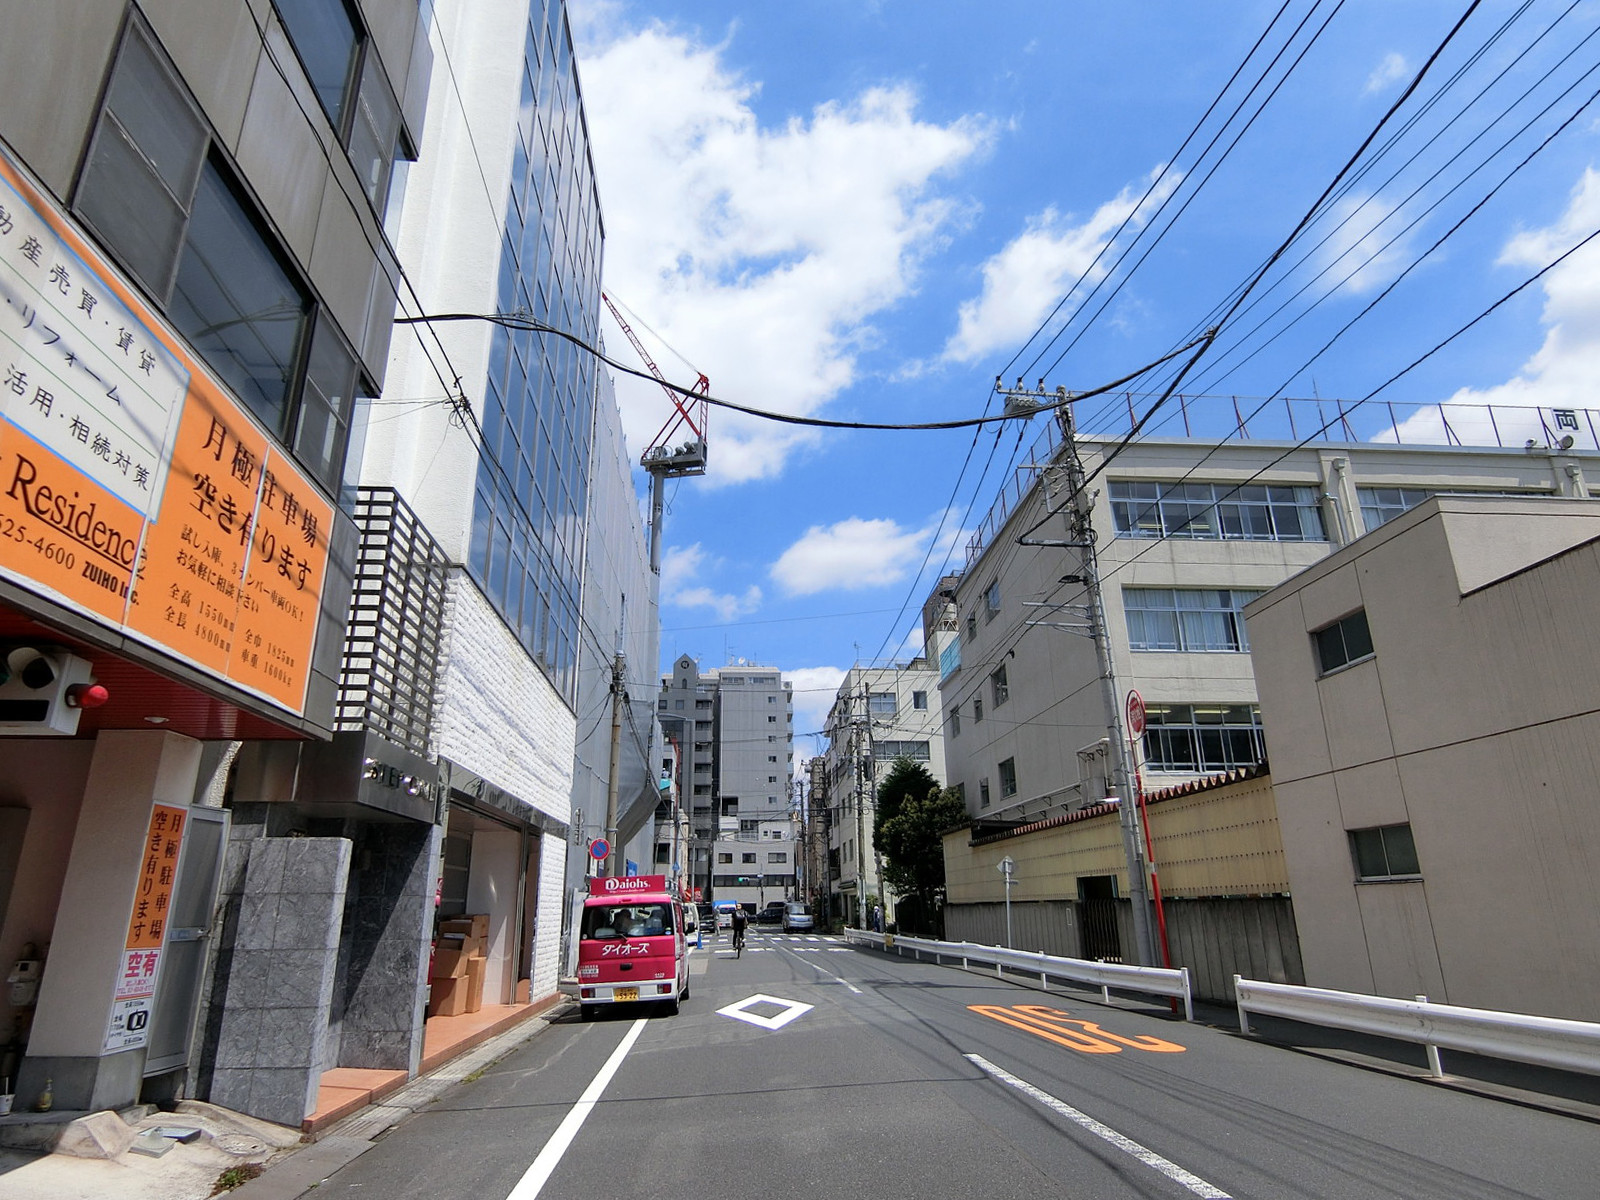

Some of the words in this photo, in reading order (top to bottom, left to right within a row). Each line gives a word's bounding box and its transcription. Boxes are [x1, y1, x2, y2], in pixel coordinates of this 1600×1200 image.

[4, 363, 151, 492] 活用・相続対策
[202, 416, 318, 548] 月極駐車場
[0, 513, 75, 569] 25-4600
[82, 561, 119, 593] ZUIHO
[189, 471, 312, 591] 空き有ります
[164, 605, 187, 630] 全長
[169, 583, 191, 608] 全高
[134, 811, 168, 942] 空き有ります
[149, 814, 182, 940] 月極駐車場
[605, 878, 648, 890] Daiohs
[124, 951, 158, 978] 空有
[602, 943, 650, 956] ダイオーズ
